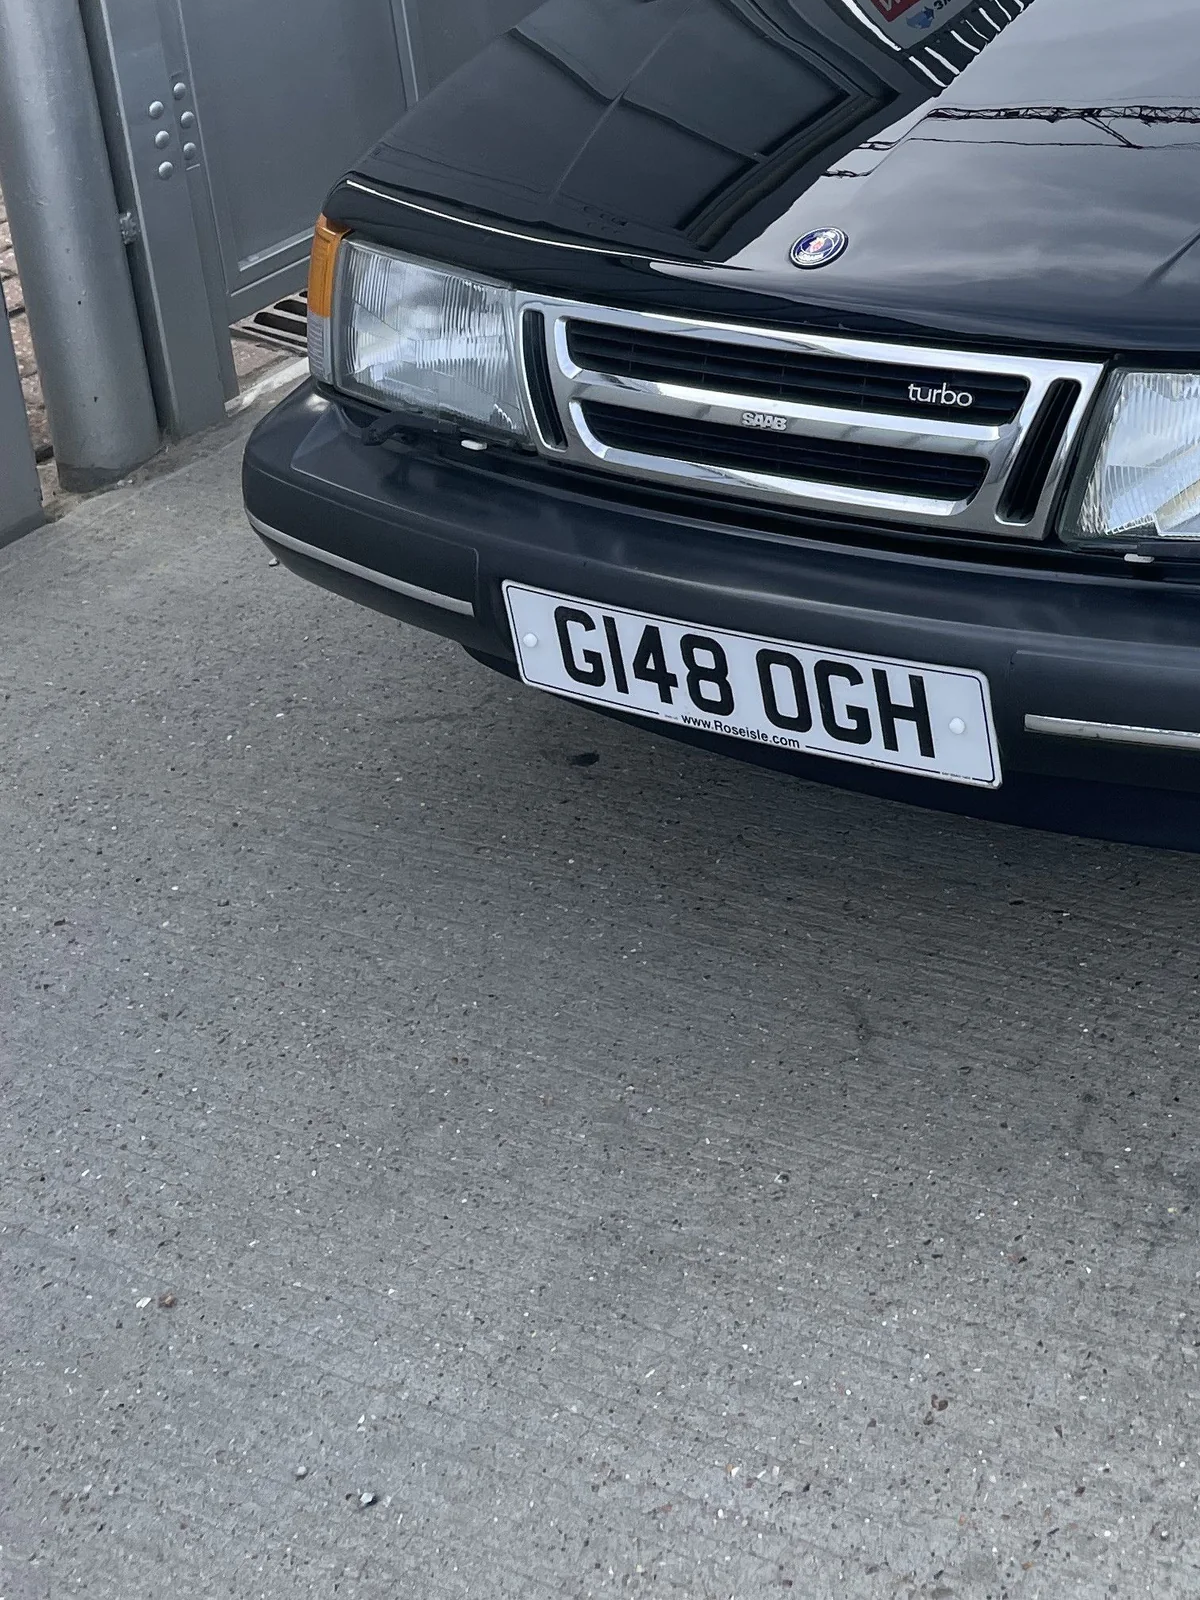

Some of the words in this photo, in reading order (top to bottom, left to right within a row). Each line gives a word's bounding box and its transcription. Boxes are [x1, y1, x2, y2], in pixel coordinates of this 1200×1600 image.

[908, 382, 973, 408] turbo
[741, 412, 787, 432] SAAB
[553, 605, 735, 717] G148
[755, 648, 936, 759] OGH
[681, 714, 800, 749] www.Roseisle.com
